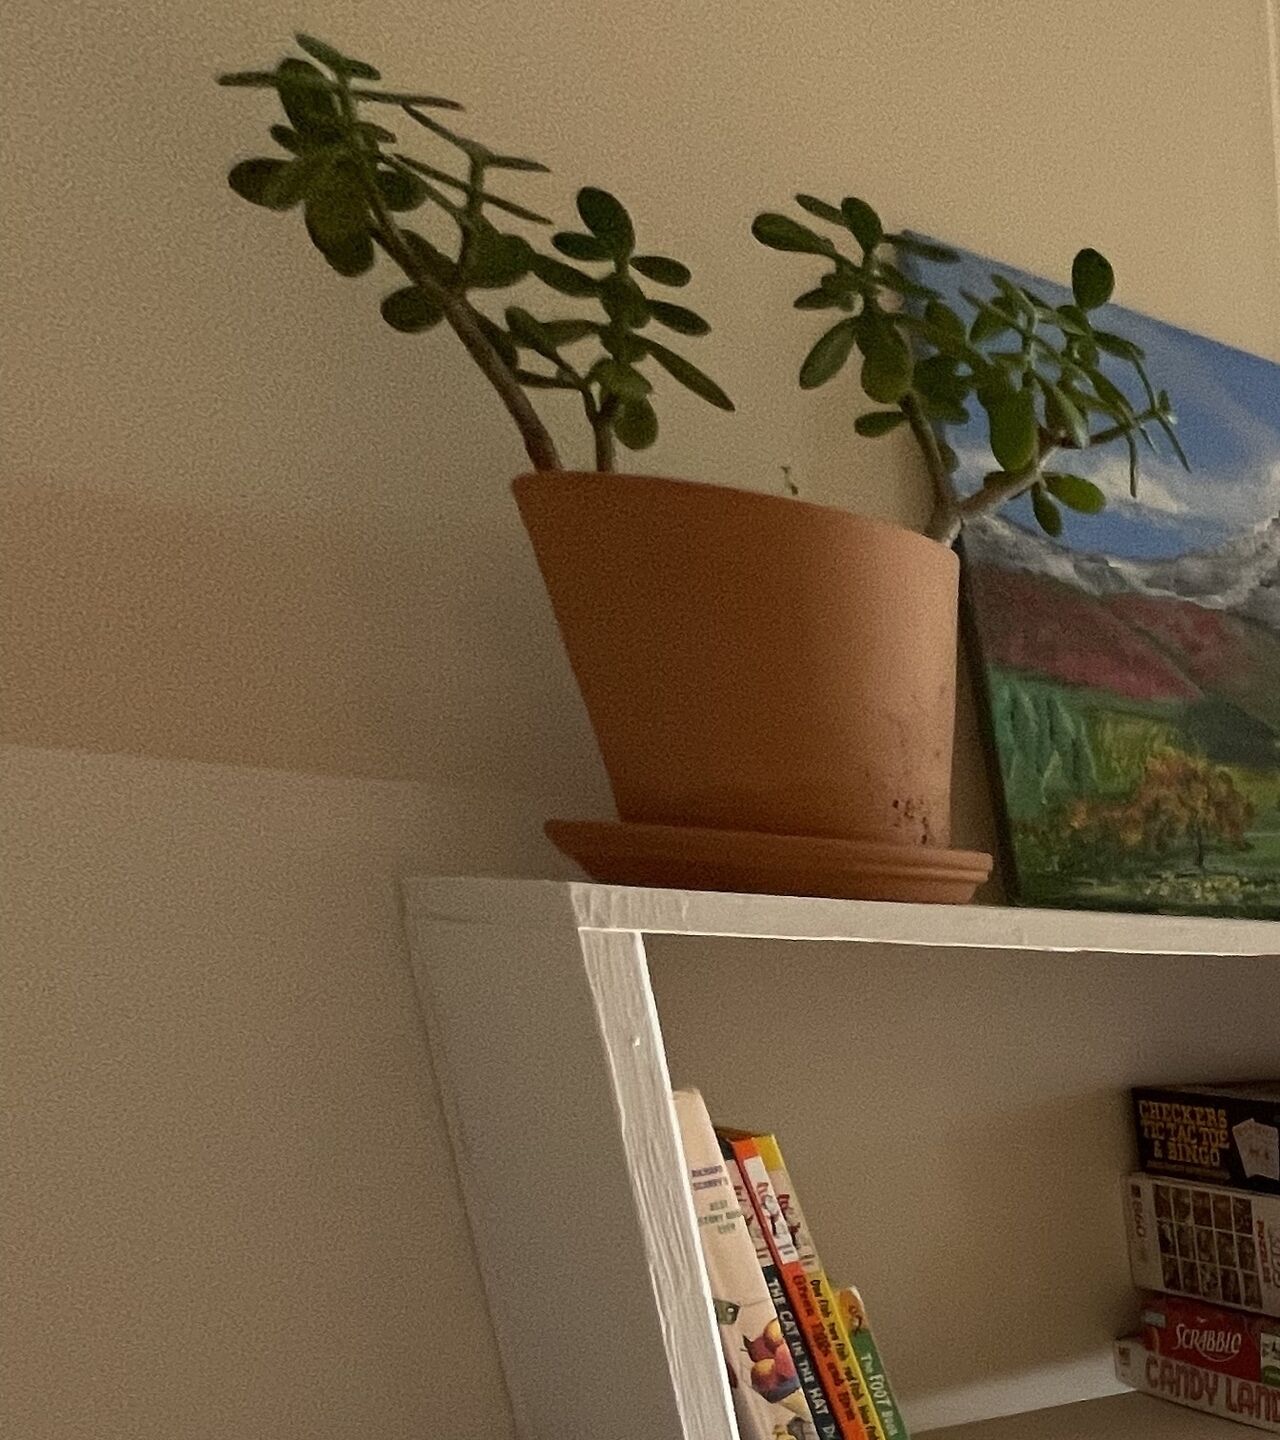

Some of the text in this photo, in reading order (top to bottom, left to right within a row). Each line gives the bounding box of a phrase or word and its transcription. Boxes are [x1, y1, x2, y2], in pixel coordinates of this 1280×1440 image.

[1139, 1100, 1229, 1129] CHECKERS
[1141, 1119, 1230, 1149] TIC TAC TOE
[1167, 1141, 1221, 1167] BINGO
[768, 1278, 786, 1306] THE
[779, 1310, 800, 1339] CAT
[791, 1340, 805, 1355] IN
[799, 1361, 815, 1383] THE
[807, 1387, 829, 1415] HAT
[1173, 1323, 1243, 1354] SCRABBLE
[868, 1373, 893, 1409] FOOT
[1145, 1355, 1219, 1406] CANDY
